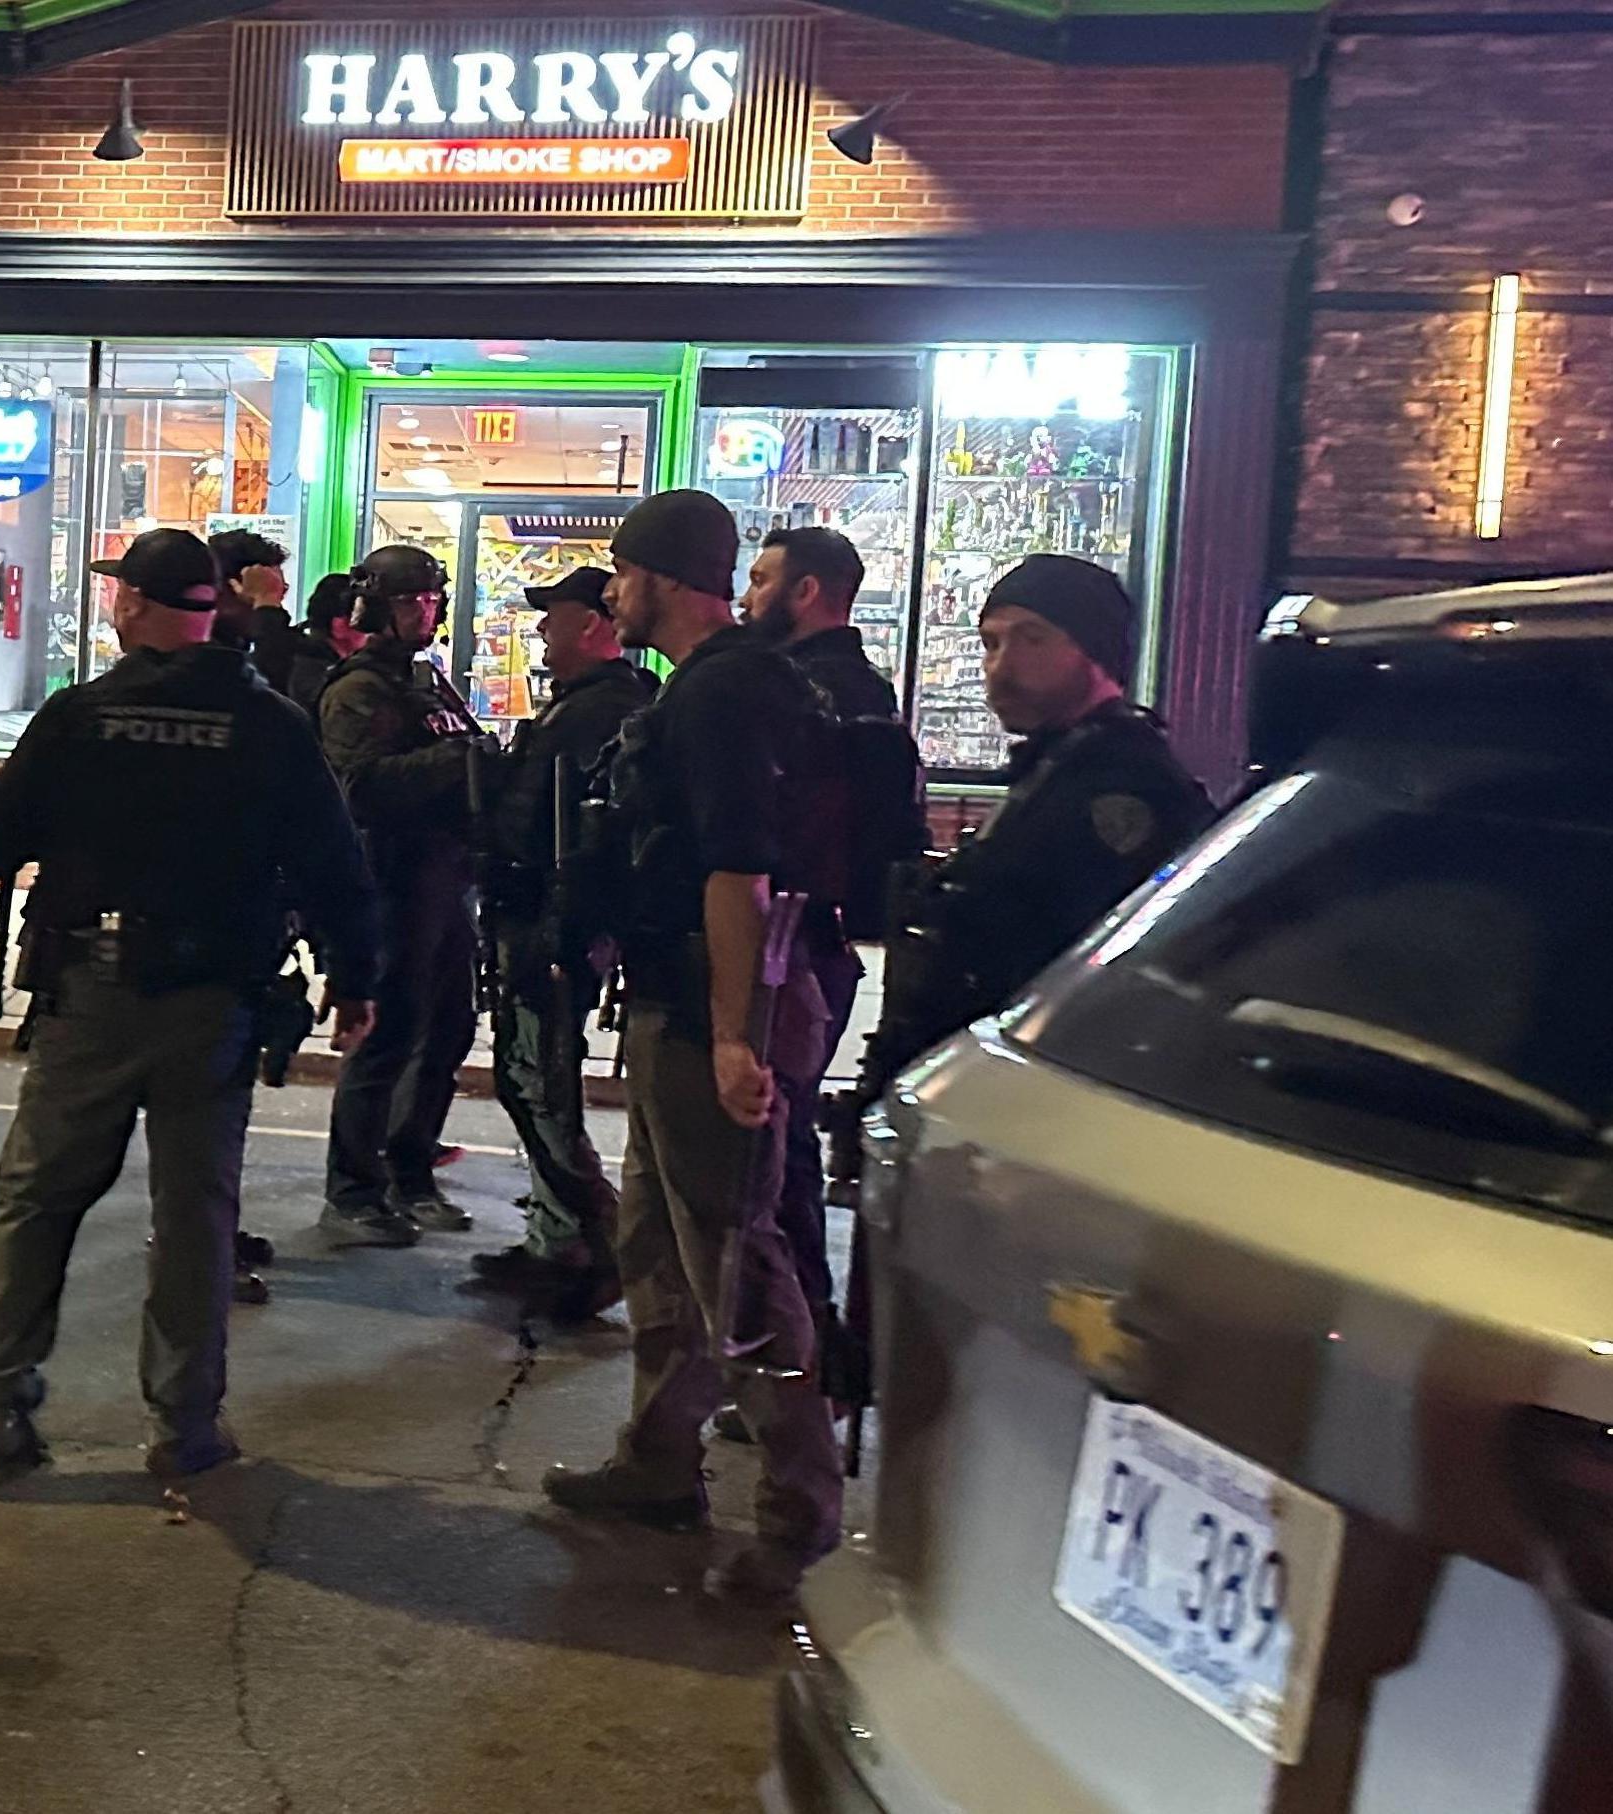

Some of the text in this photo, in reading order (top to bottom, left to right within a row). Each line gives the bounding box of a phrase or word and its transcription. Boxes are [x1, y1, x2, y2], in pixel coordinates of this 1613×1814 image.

[301, 31, 739, 125] HARRY'S
[355, 146, 673, 174] MART/SMOKE SHOP
[98, 718, 230, 748] POLICE
